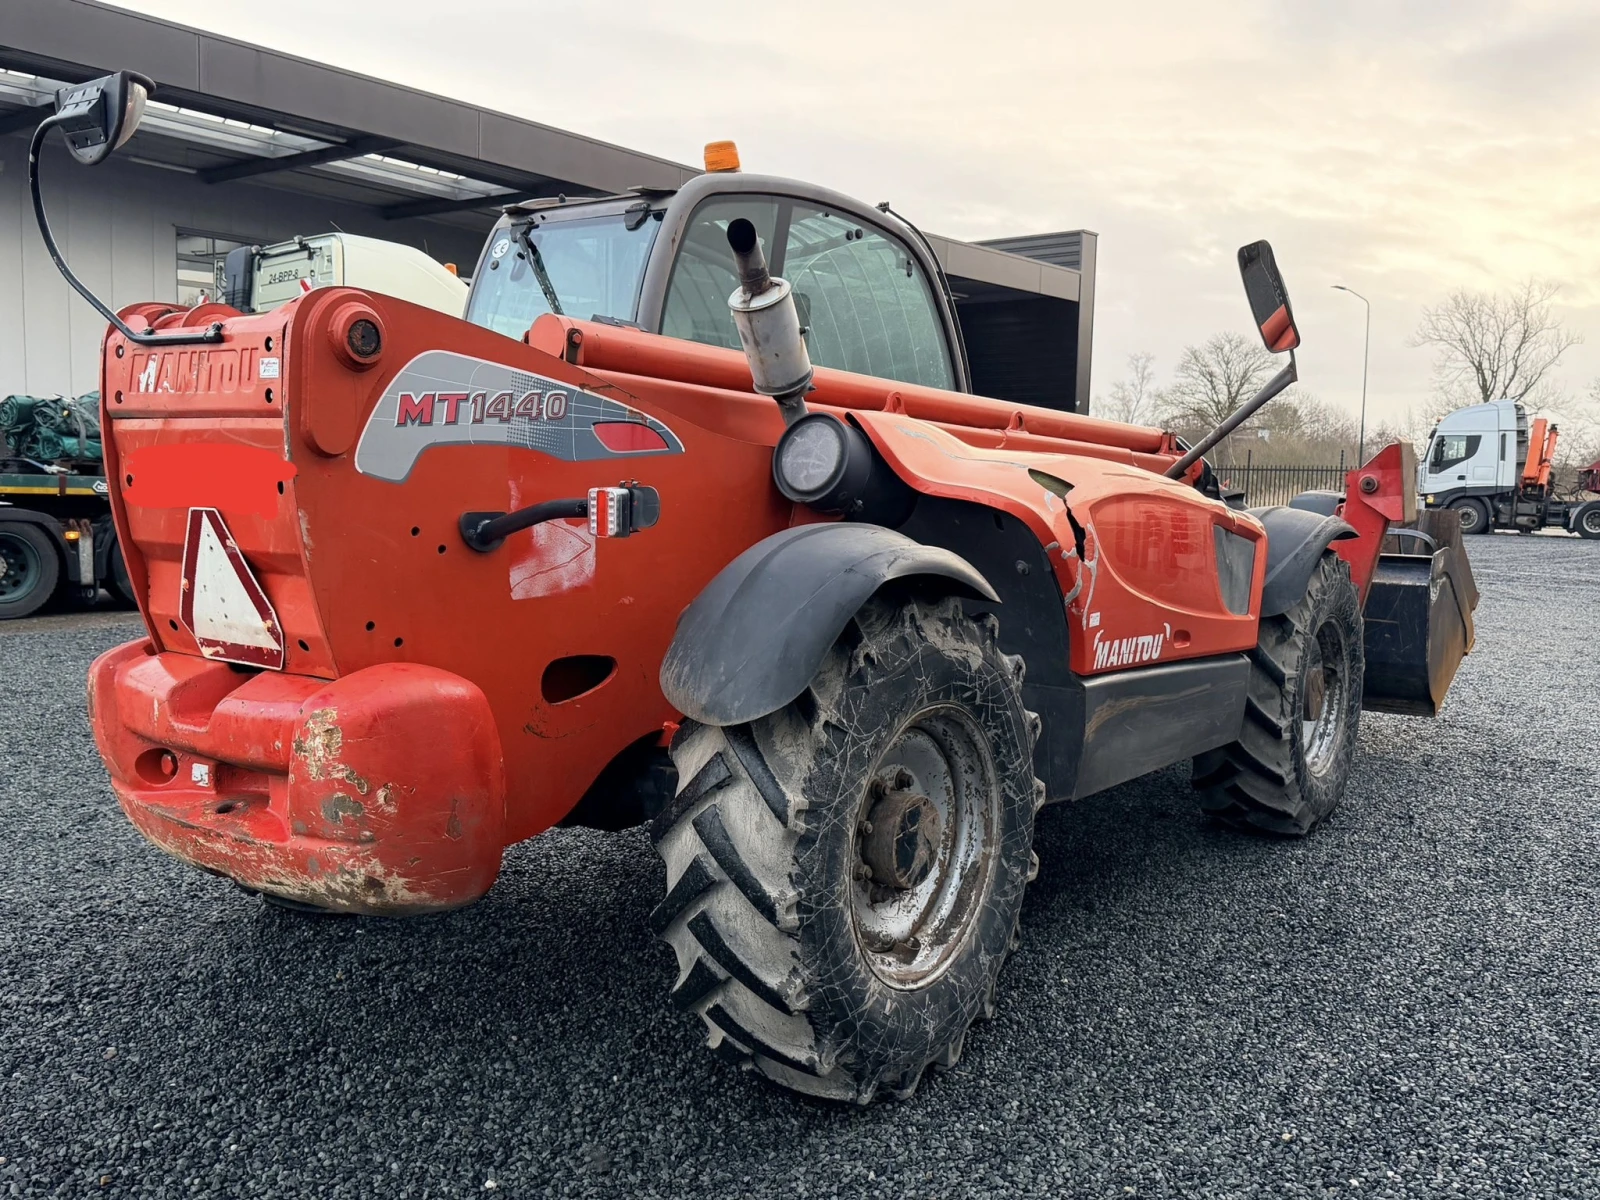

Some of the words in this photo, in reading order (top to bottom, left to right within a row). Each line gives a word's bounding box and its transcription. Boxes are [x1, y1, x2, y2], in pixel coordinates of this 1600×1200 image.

[493, 242, 508, 255] CE
[129, 347, 259, 394] MANITOU
[394, 390, 568, 427] MT1440
[1093, 633, 1164, 670] MANITOU
